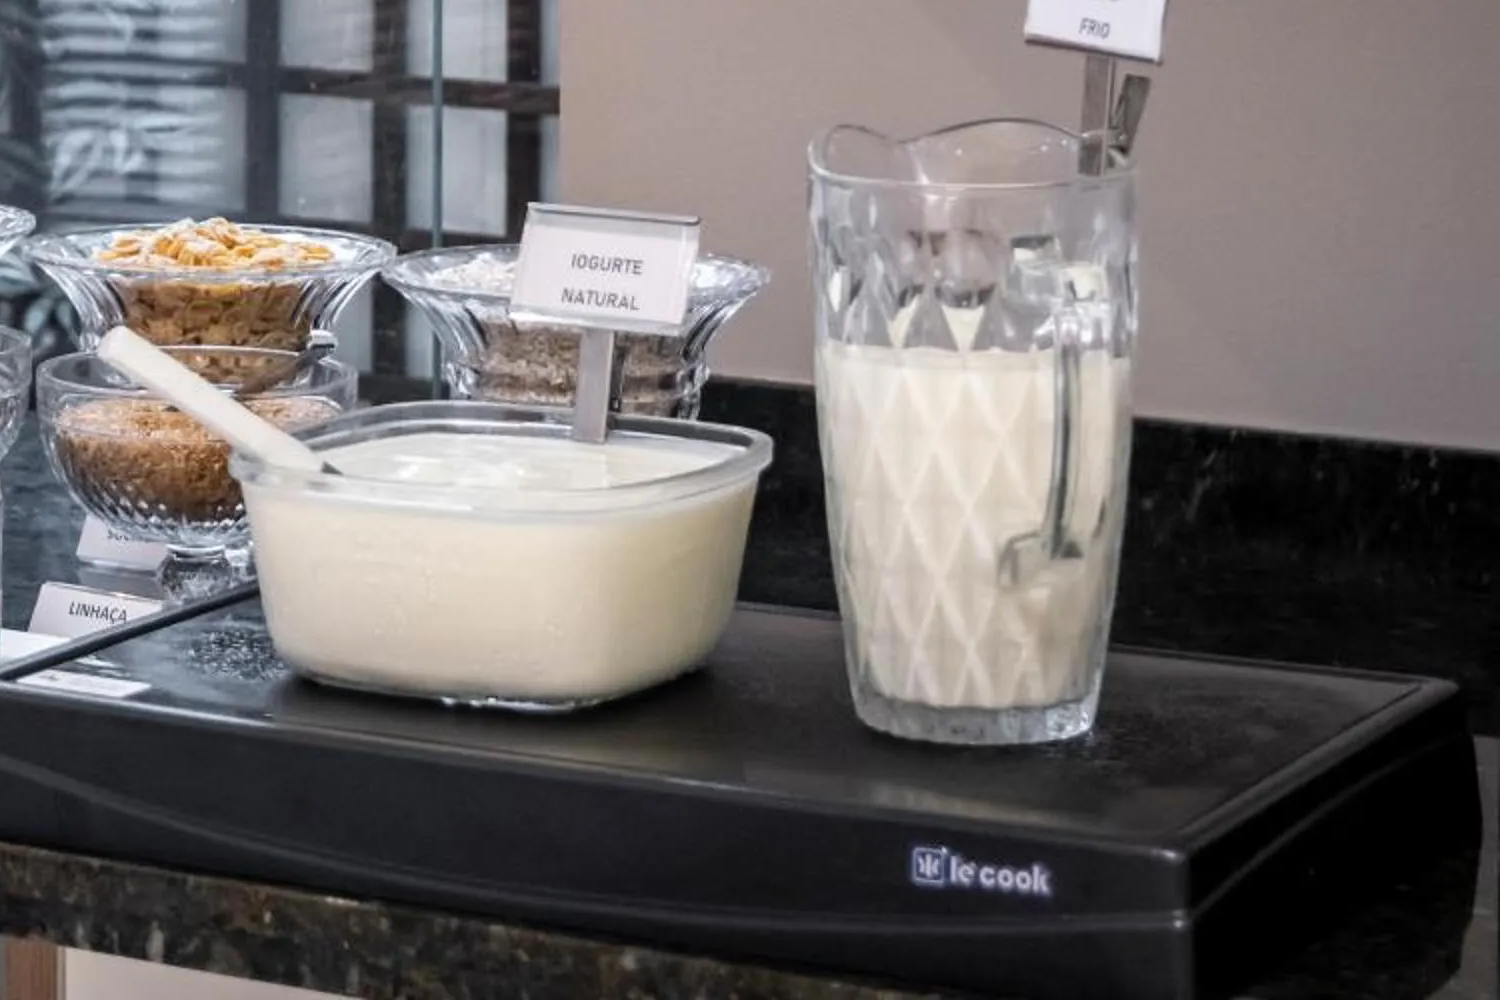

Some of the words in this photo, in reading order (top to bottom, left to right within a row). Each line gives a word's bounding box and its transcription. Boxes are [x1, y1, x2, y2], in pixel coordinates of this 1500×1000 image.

[1078, 17, 1111, 39] FRIO
[571, 253, 644, 275] IOGURTE
[561, 287, 641, 311] NATURAL
[68, 601, 128, 624] LINHAÇA
